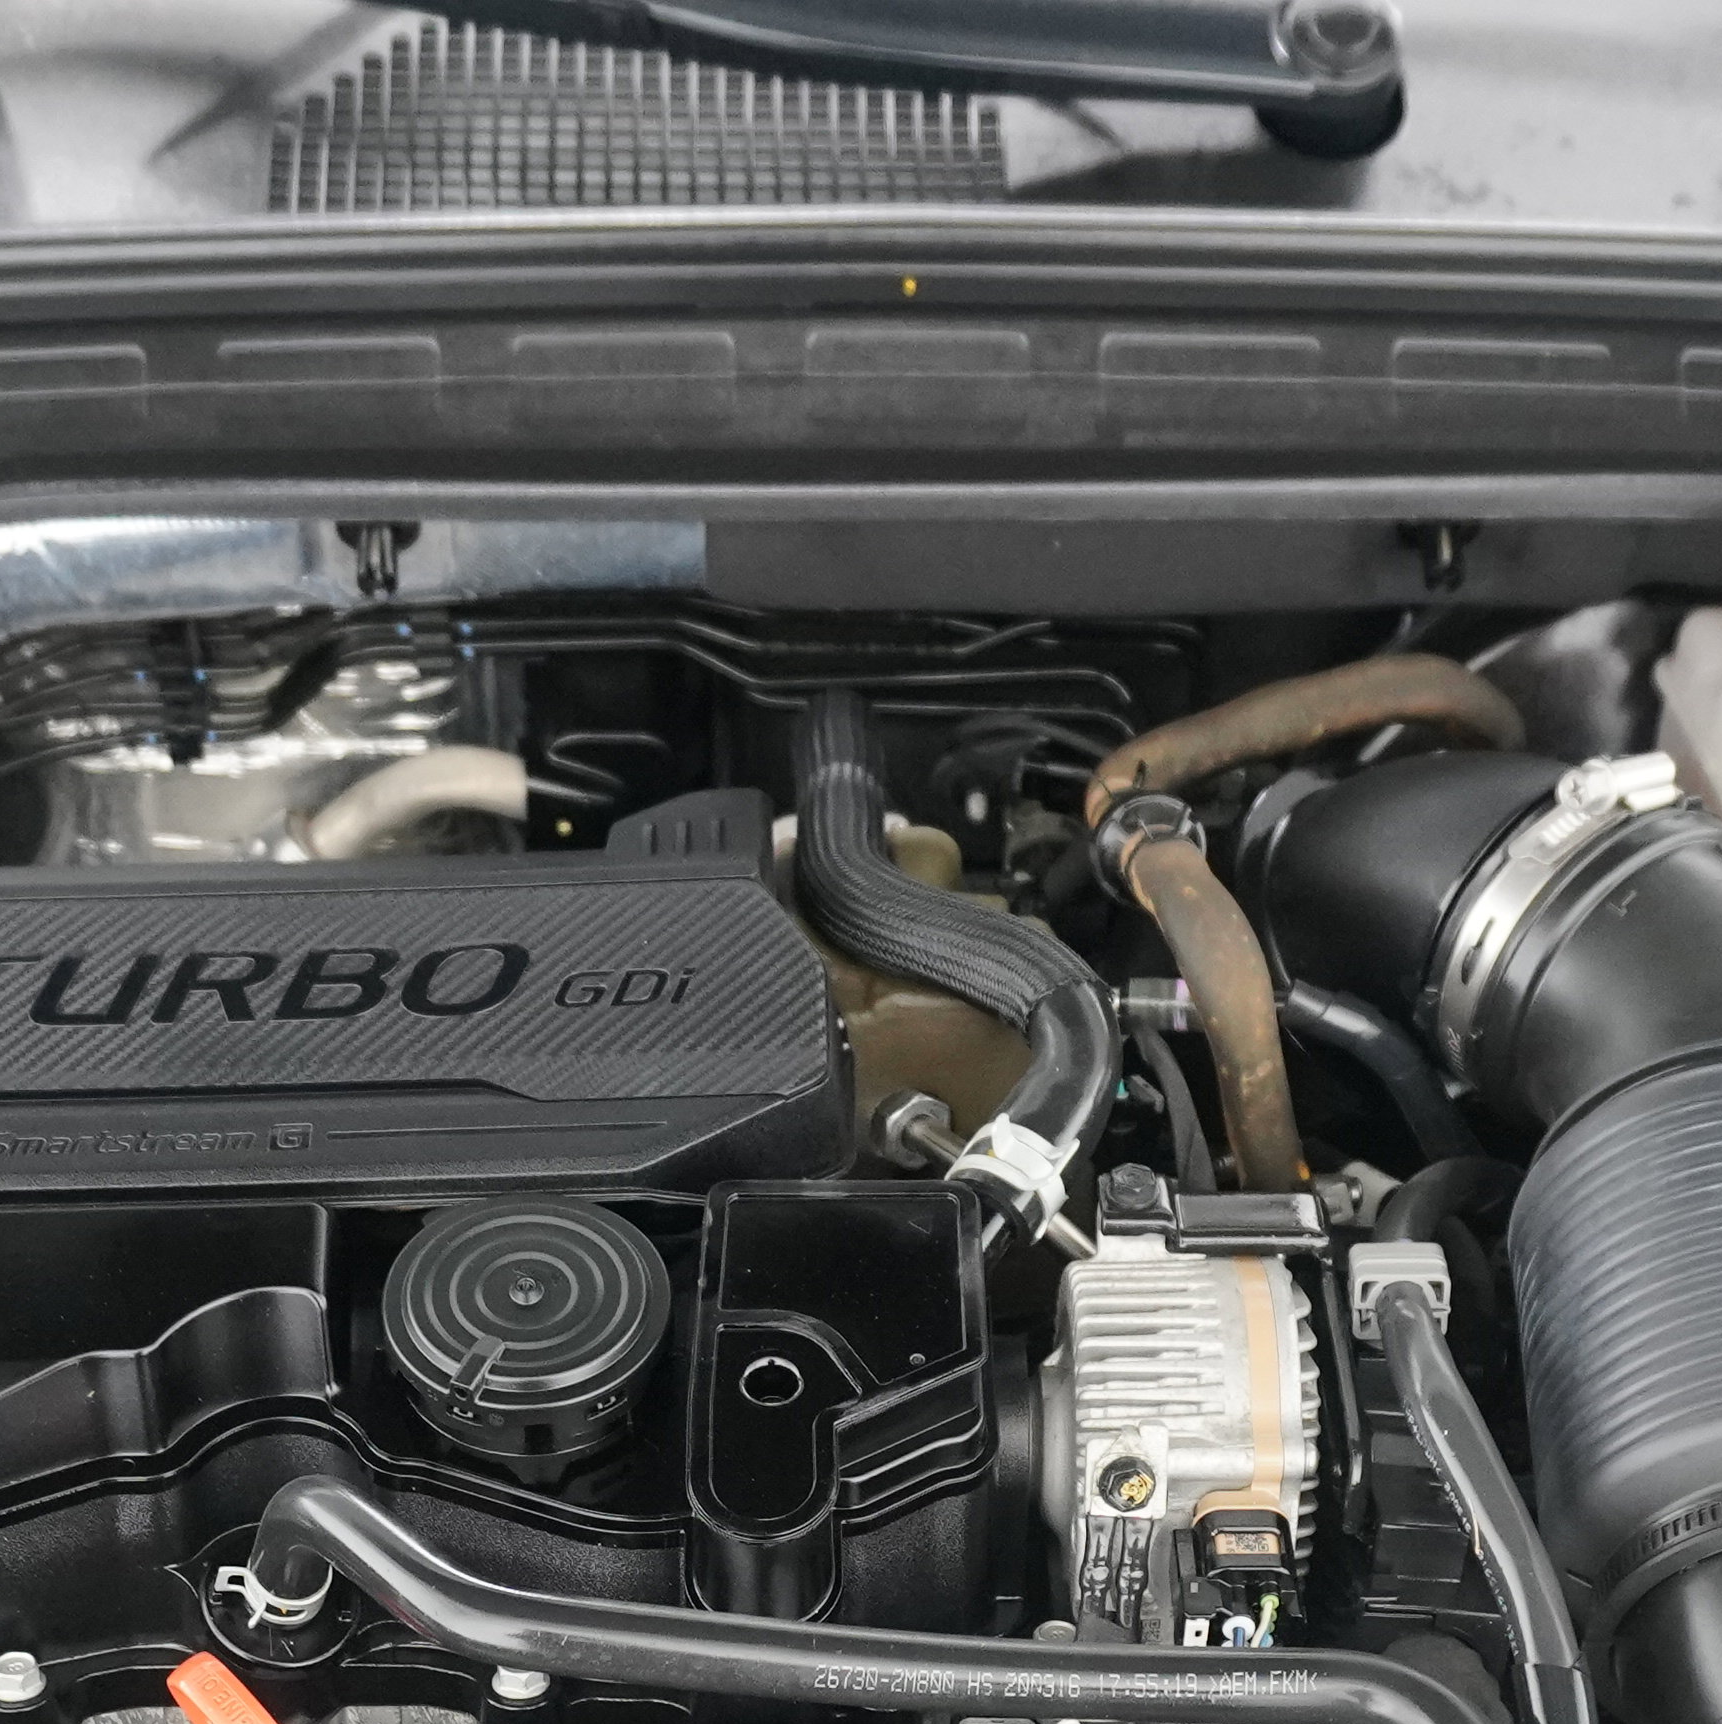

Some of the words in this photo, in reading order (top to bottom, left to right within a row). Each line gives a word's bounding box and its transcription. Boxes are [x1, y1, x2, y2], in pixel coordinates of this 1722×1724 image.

[554, 966, 695, 1008] GDi
[813, 1664, 955, 1695] 26730-2M800
[967, 1673, 994, 1696] HS
